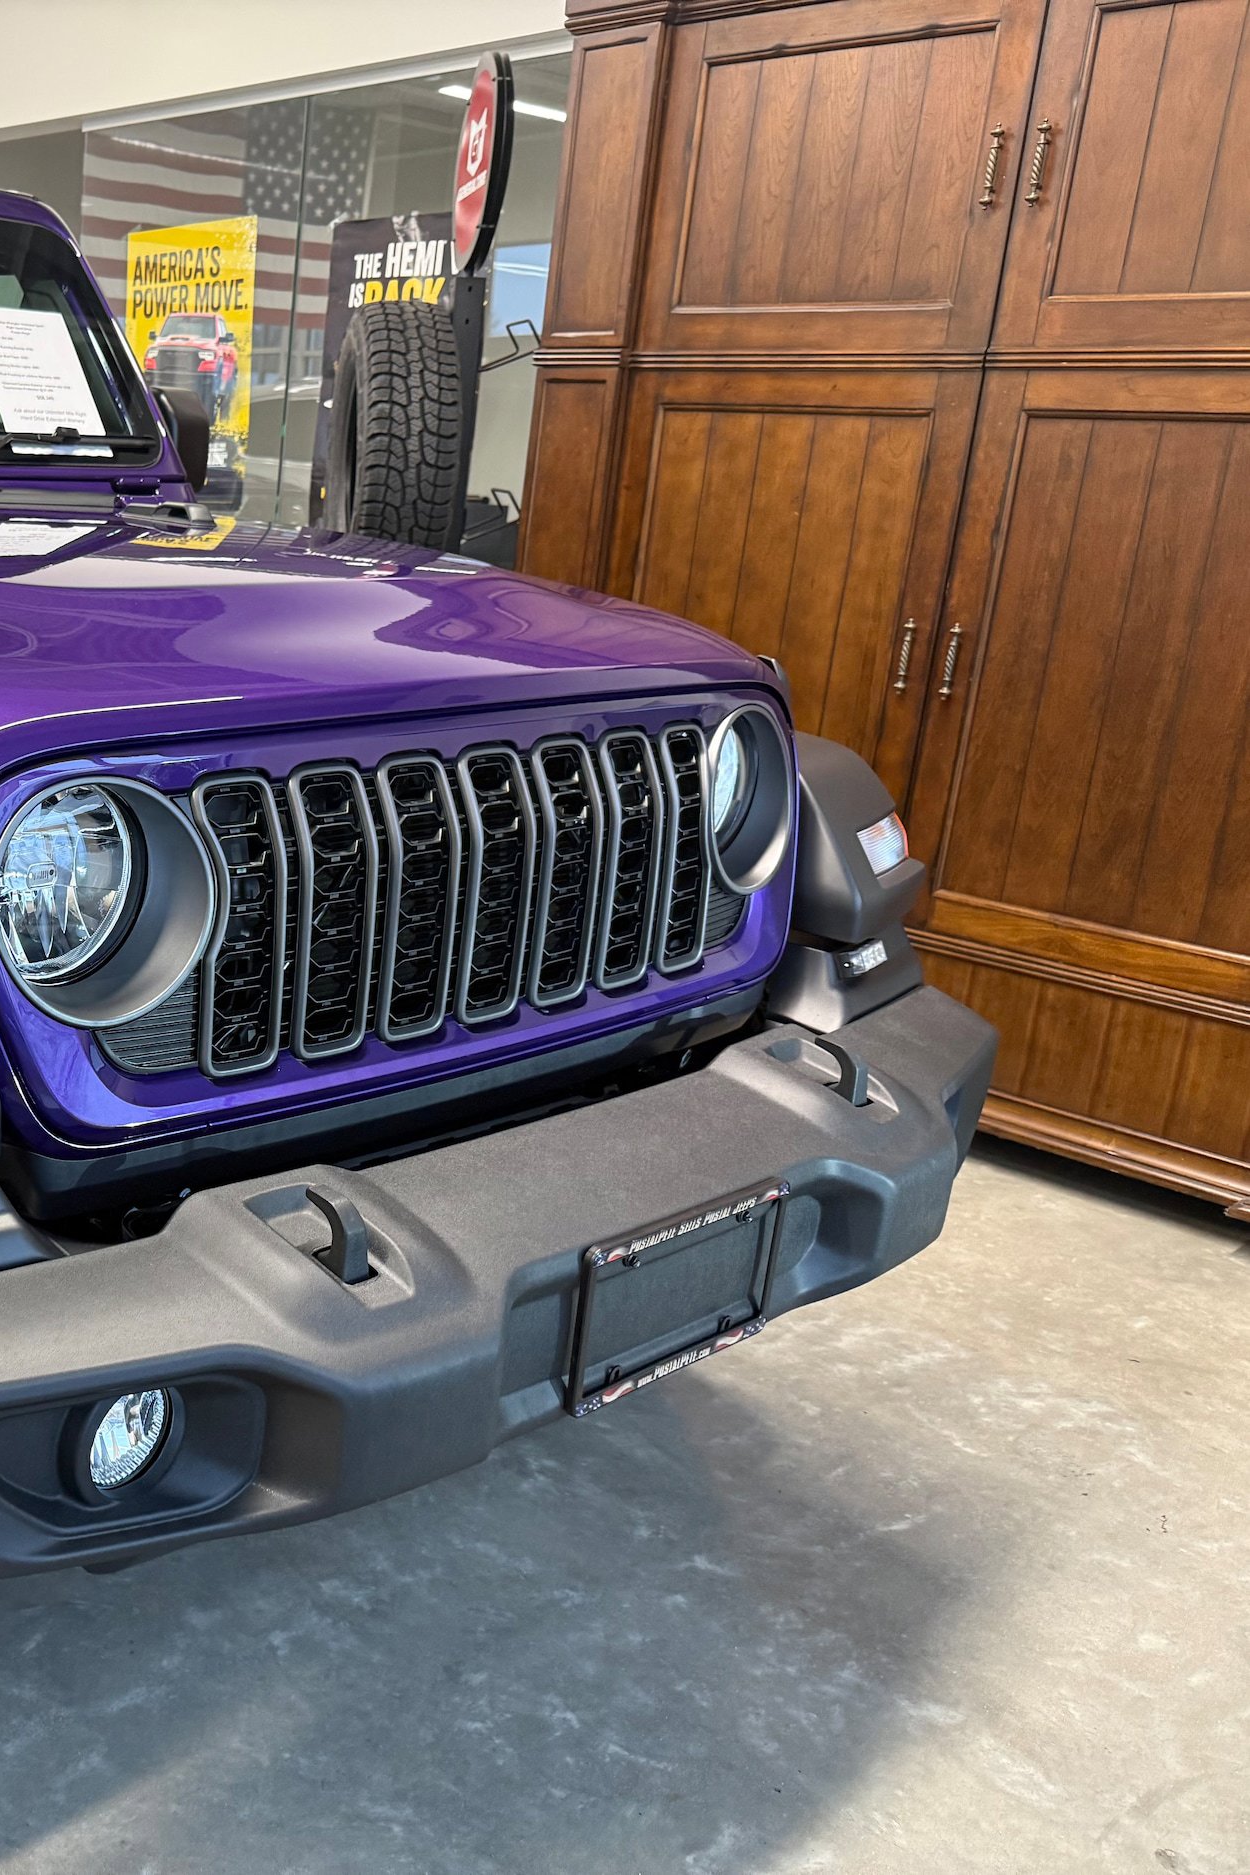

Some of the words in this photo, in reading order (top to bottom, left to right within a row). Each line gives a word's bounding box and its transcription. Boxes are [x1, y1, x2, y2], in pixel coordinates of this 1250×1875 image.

[132, 246, 221, 287] AMERICA'S
[354, 252, 383, 279] THE
[385, 240, 447, 278] HEMI
[132, 284, 189, 319] POWER
[194, 278, 248, 313] MOVE.
[348, 282, 365, 308] IS
